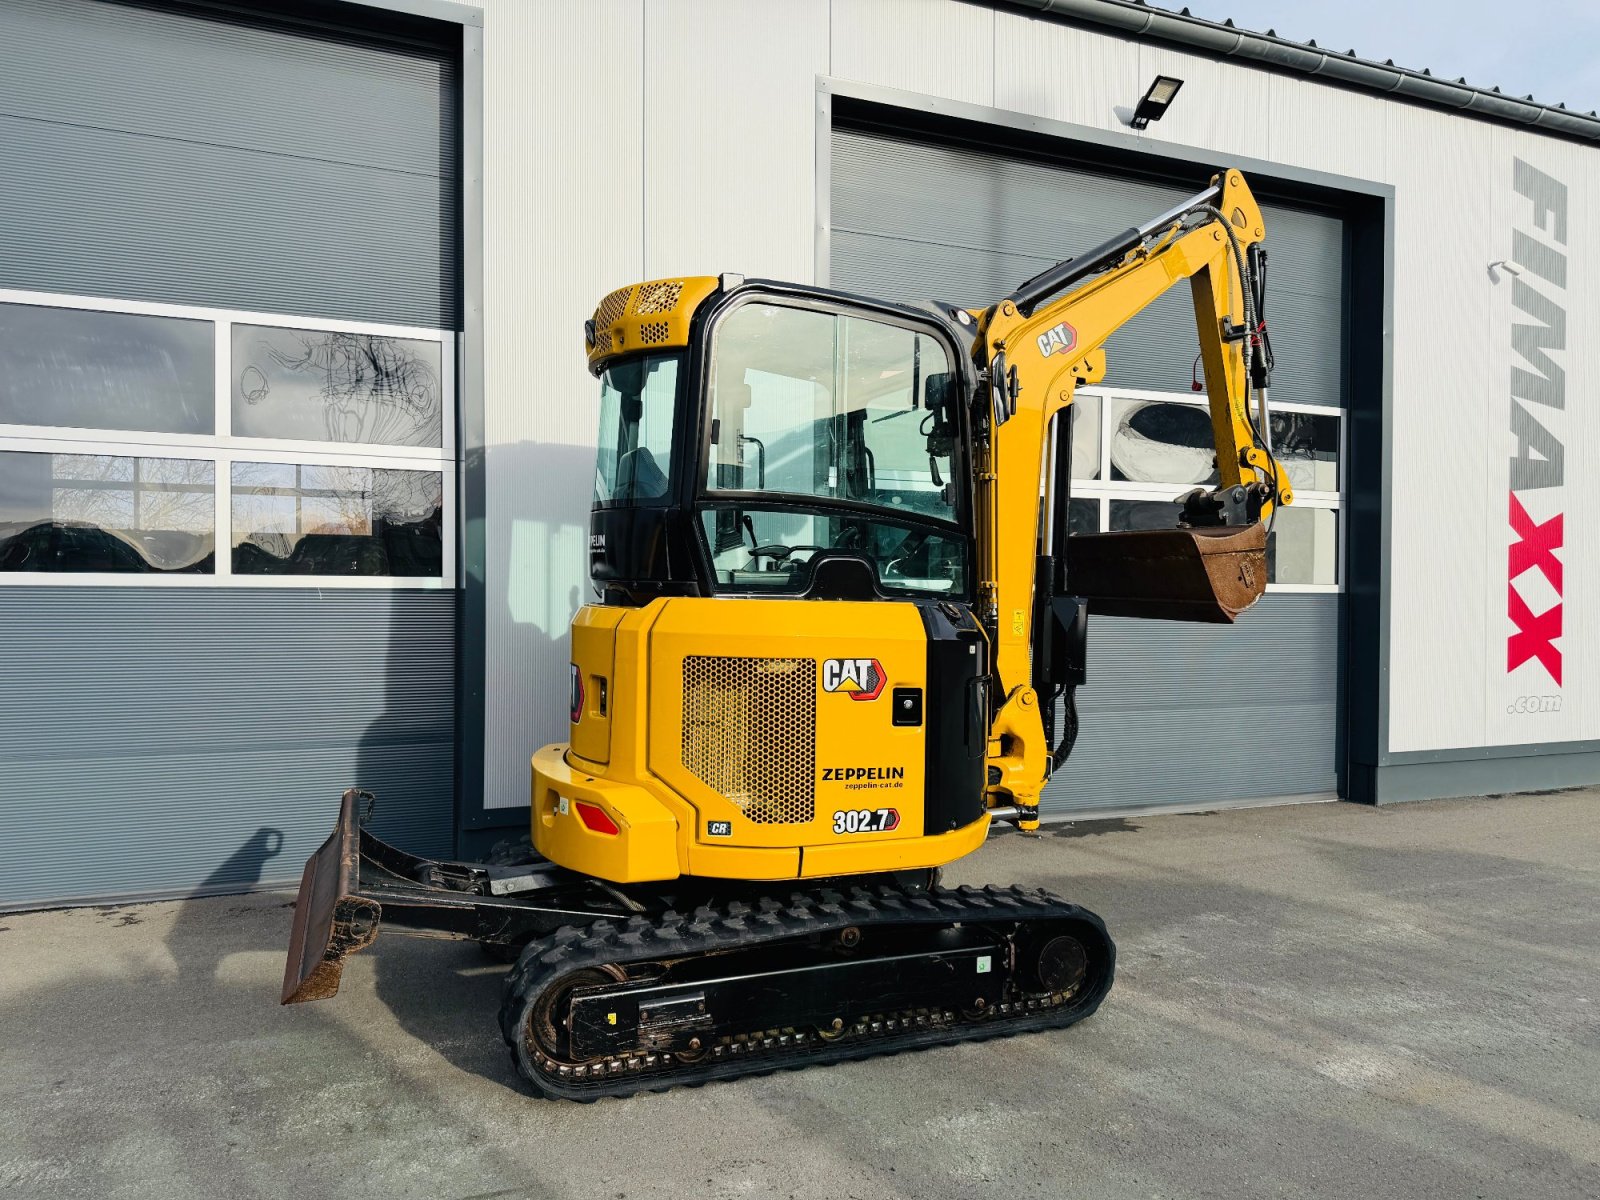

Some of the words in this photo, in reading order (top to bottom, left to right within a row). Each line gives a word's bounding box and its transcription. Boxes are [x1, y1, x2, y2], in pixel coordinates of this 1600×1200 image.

[1037, 322, 1069, 358] CAT
[1507, 155, 1568, 688] FIMAXX
[823, 659, 872, 692] CAT
[1506, 695, 1562, 714] .com
[822, 767, 904, 781] ZEPPELIN
[845, 782, 904, 791] zeppelin-cat.de
[711, 822, 728, 834] CR
[833, 809, 889, 833] 302.7
